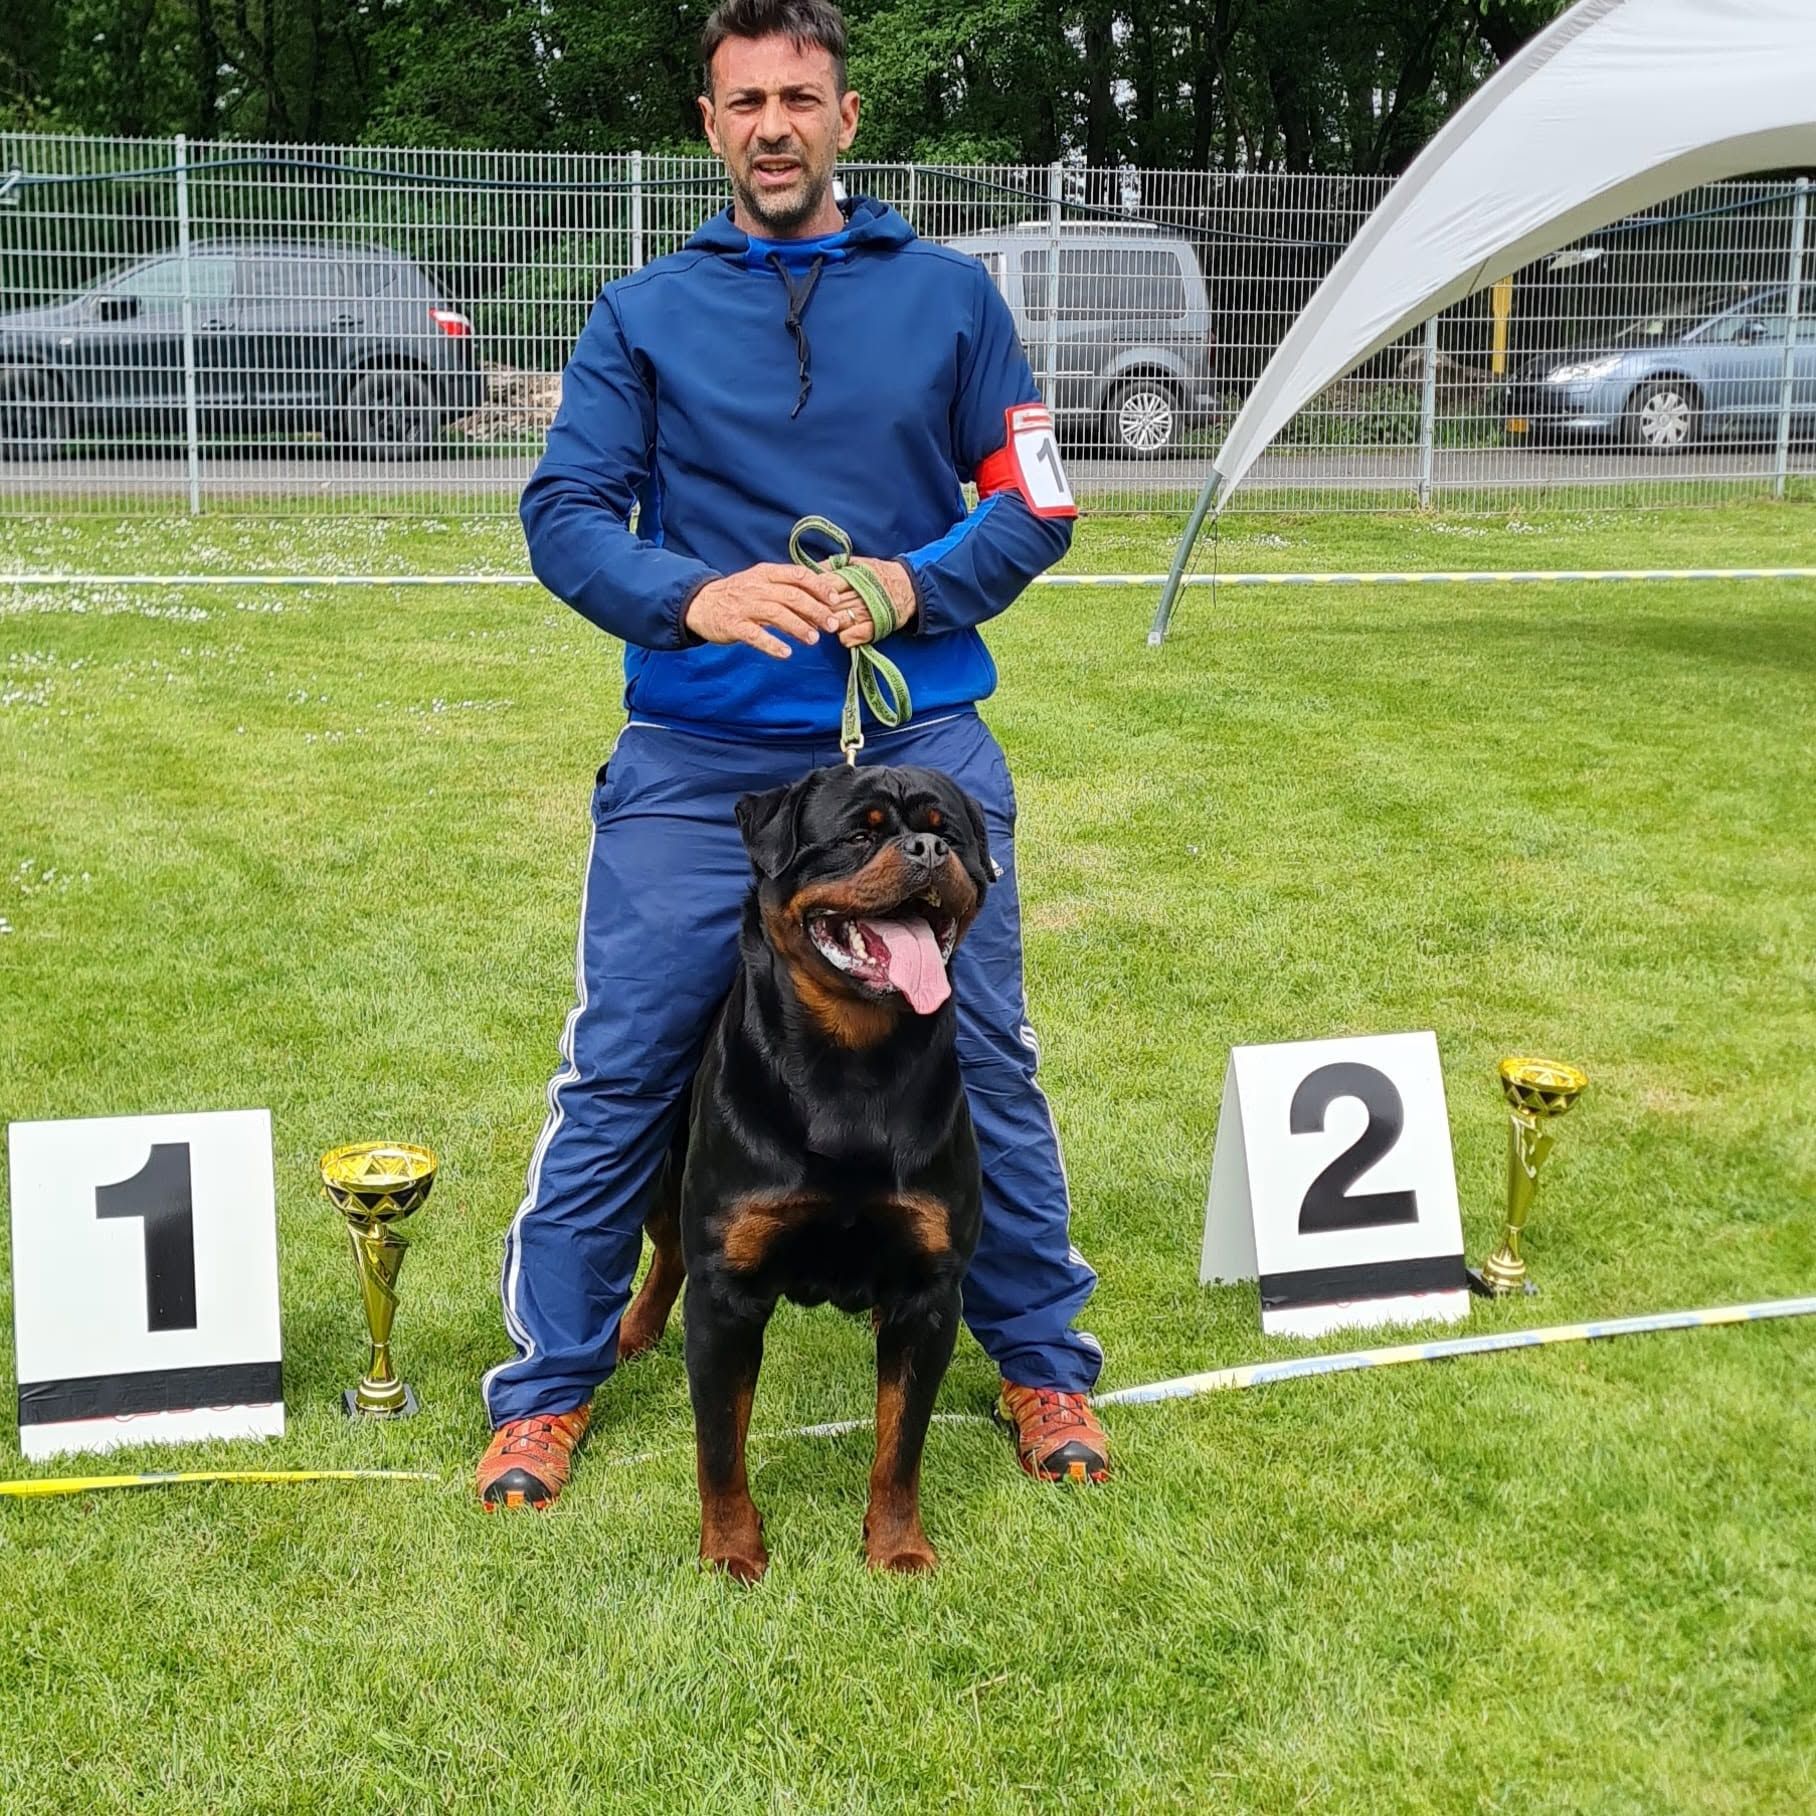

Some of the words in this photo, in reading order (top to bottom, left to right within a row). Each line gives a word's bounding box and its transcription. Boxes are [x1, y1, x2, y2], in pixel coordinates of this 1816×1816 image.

[1037, 437, 1065, 493] 1
[1290, 1061, 1420, 1235] 2
[95, 1142, 197, 1332] 1
